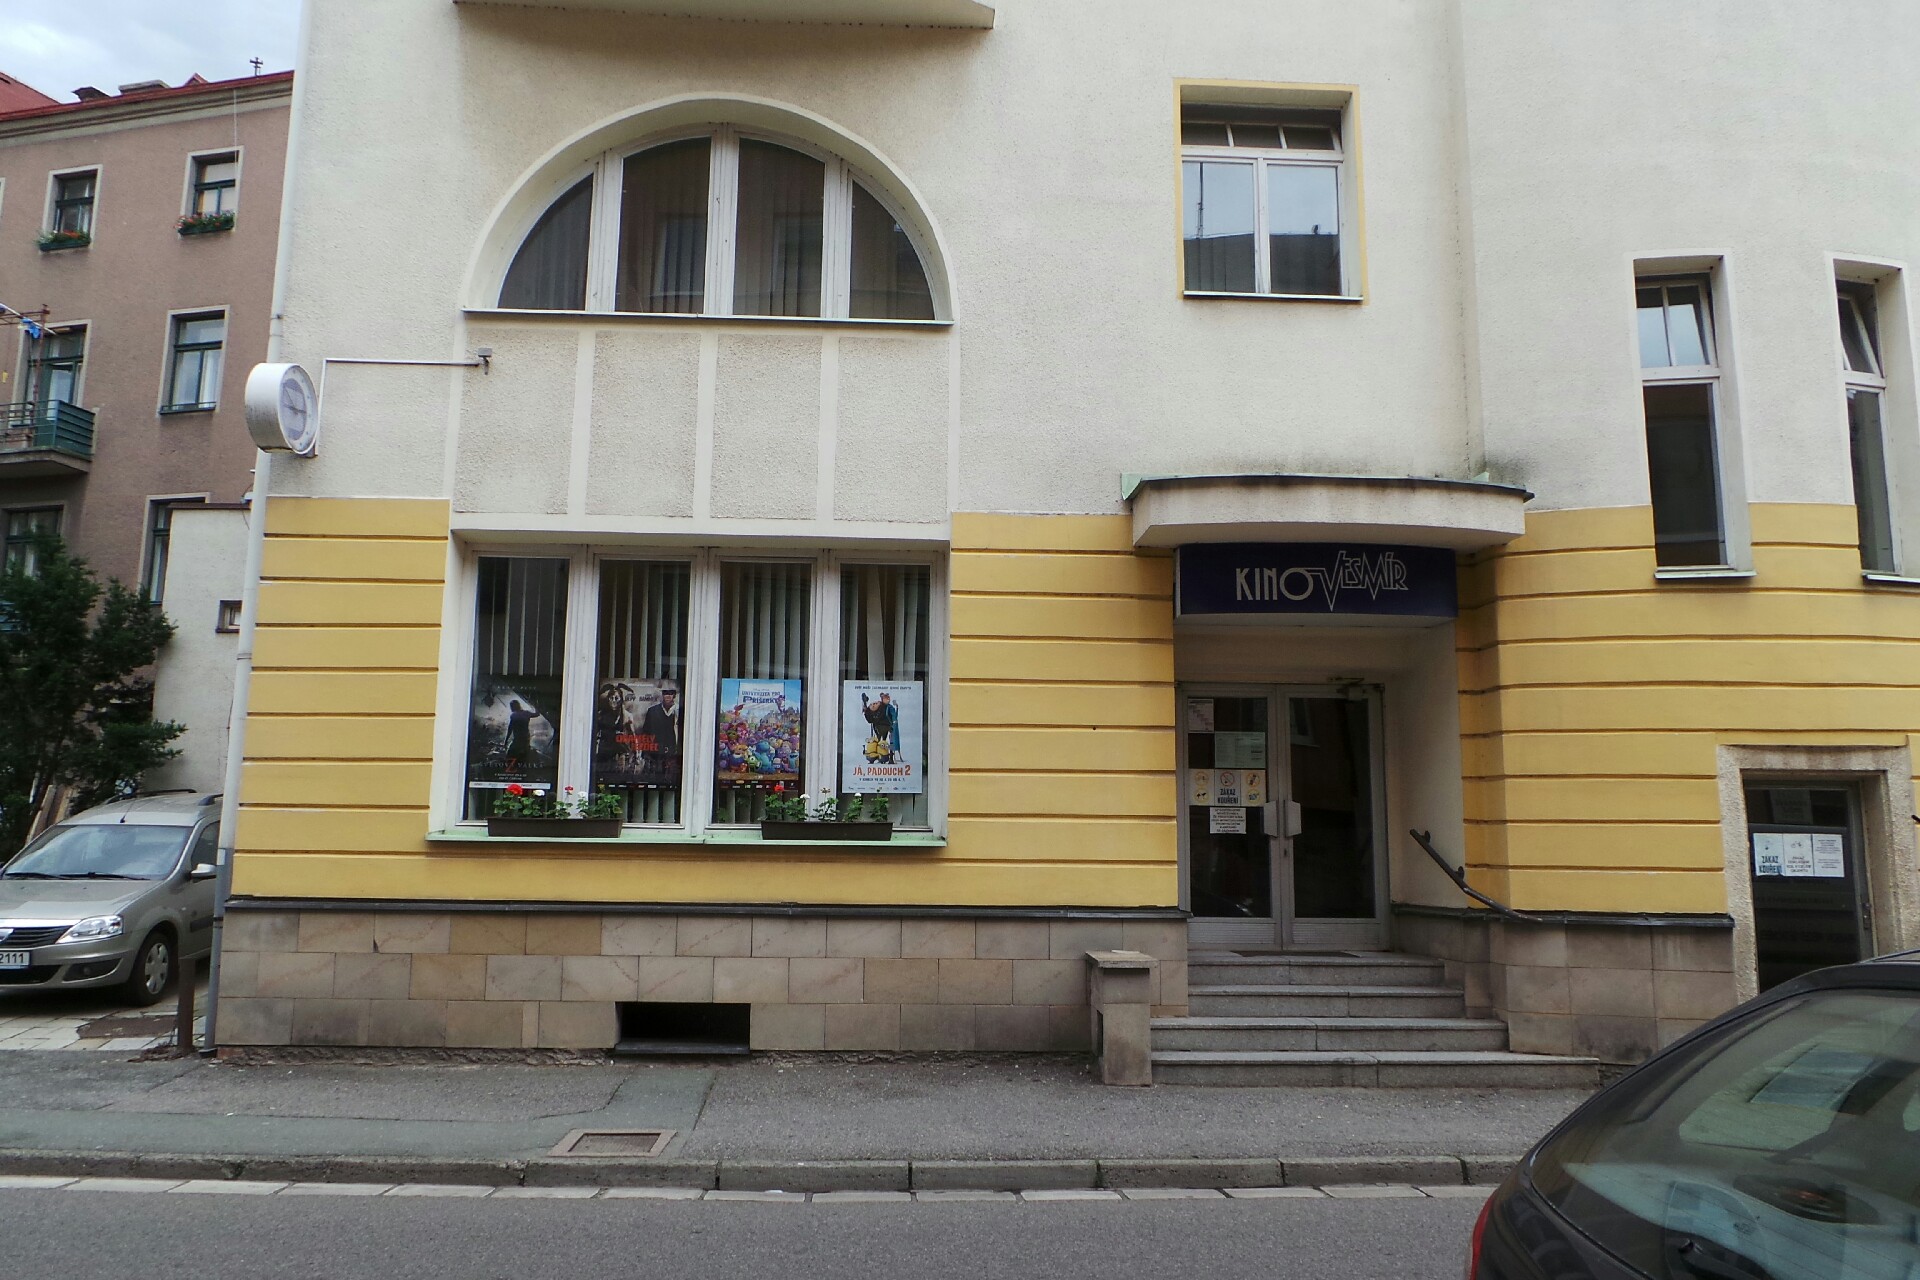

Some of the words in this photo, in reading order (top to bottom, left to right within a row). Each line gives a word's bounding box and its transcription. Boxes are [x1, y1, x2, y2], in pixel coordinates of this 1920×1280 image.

[1236, 568, 1314, 601] KINO
[1312, 551, 1409, 612] VESMÍR
[868, 767, 903, 776] PADOUCH
[905, 765, 911, 776] 2
[0, 952, 24, 964] 2111
